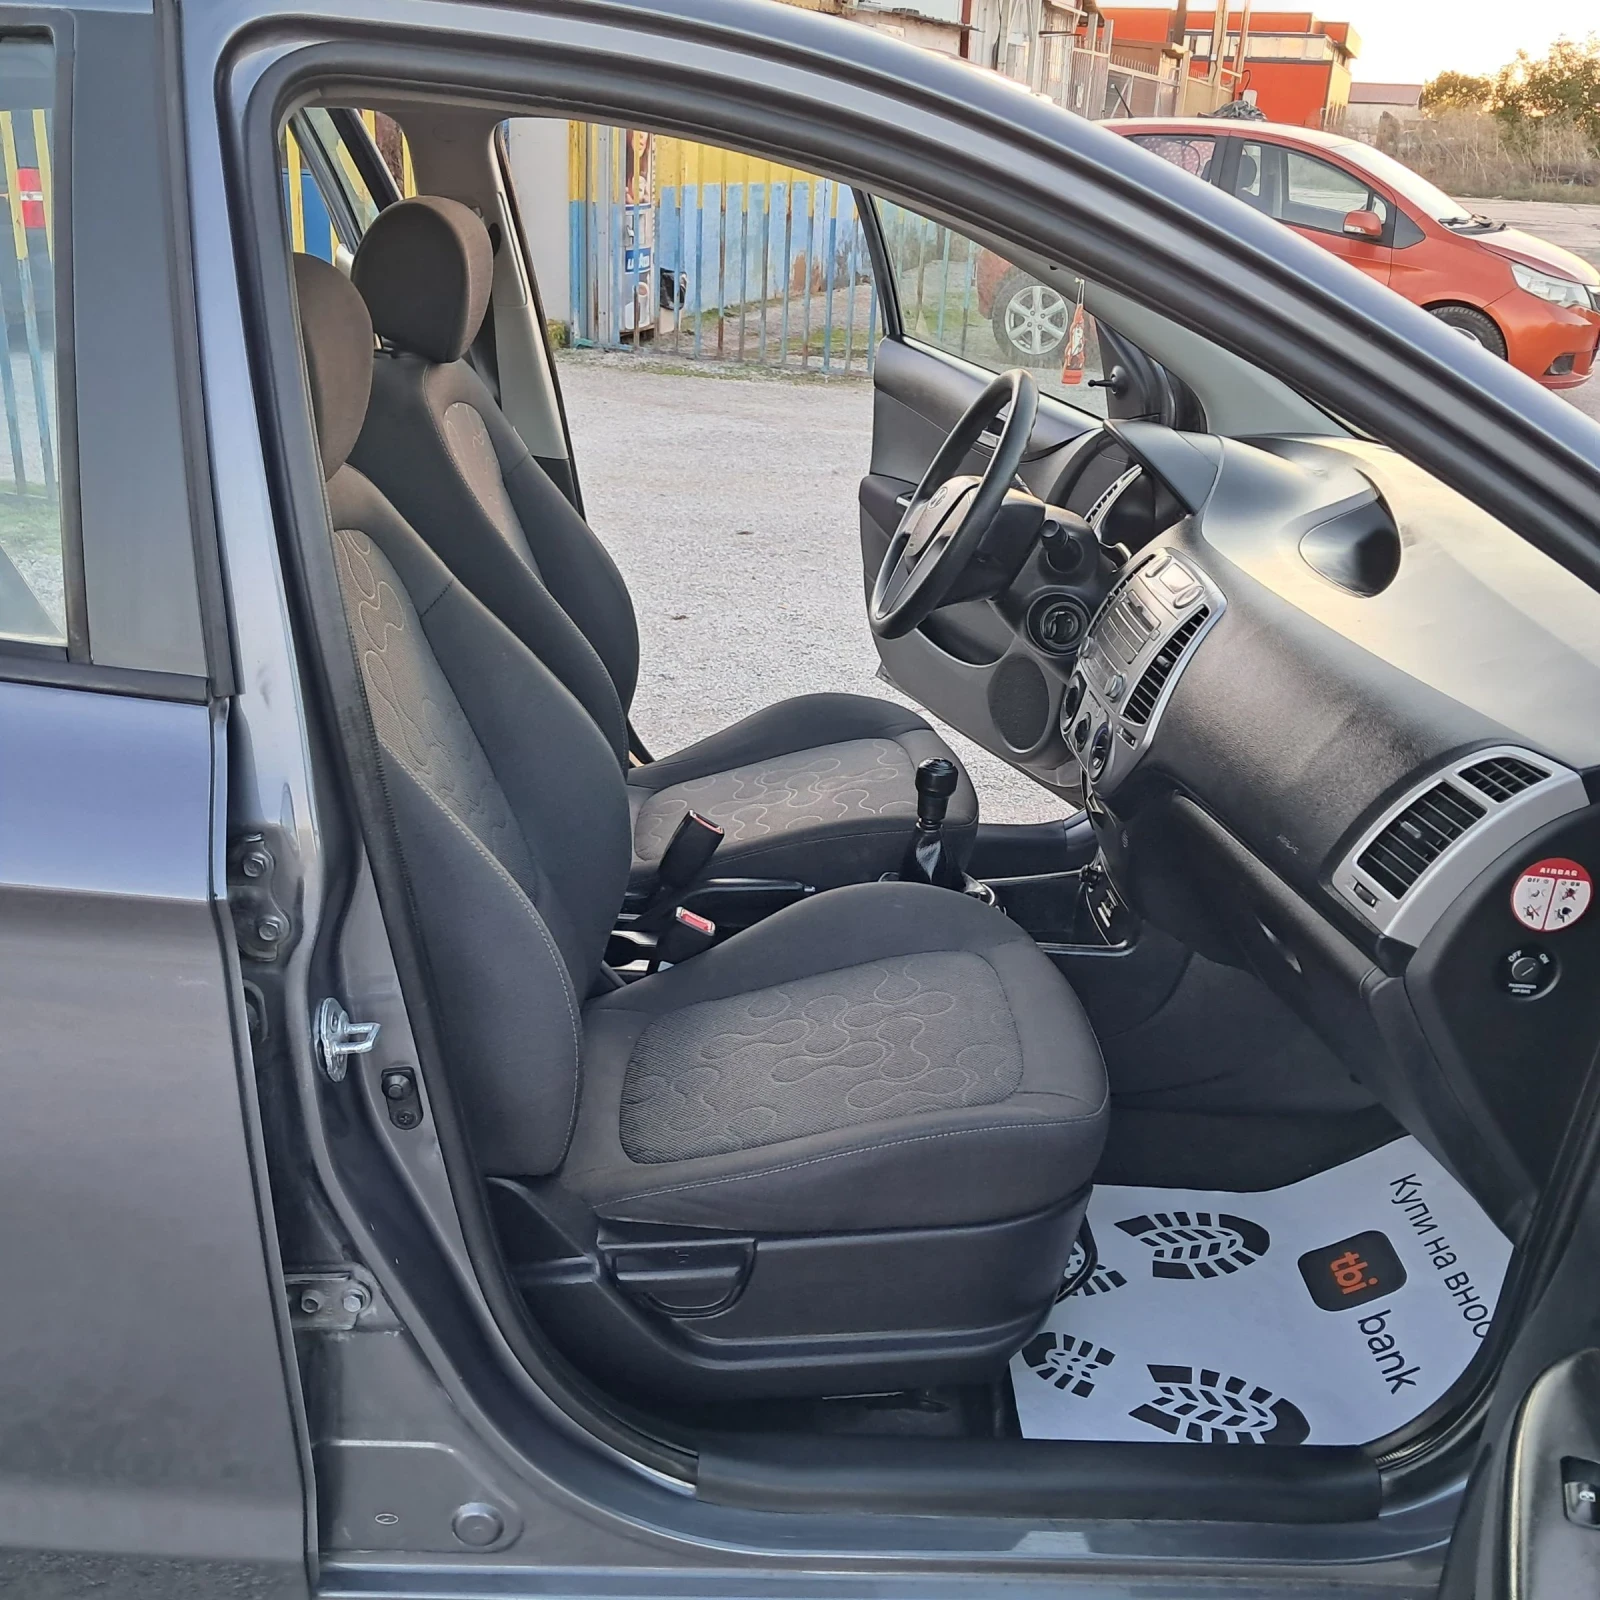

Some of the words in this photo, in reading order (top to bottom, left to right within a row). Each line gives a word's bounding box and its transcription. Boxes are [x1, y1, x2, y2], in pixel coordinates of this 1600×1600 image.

[1539, 867, 1578, 877] AIRBAG
[1508, 950, 1522, 962] OFF
[1539, 953, 1550, 964] ON
[1390, 1173, 1438, 1235] Купи
[1424, 1236, 1457, 1270] на
[1330, 1251, 1378, 1295] tbi
[1357, 1309, 1420, 1395] bank
